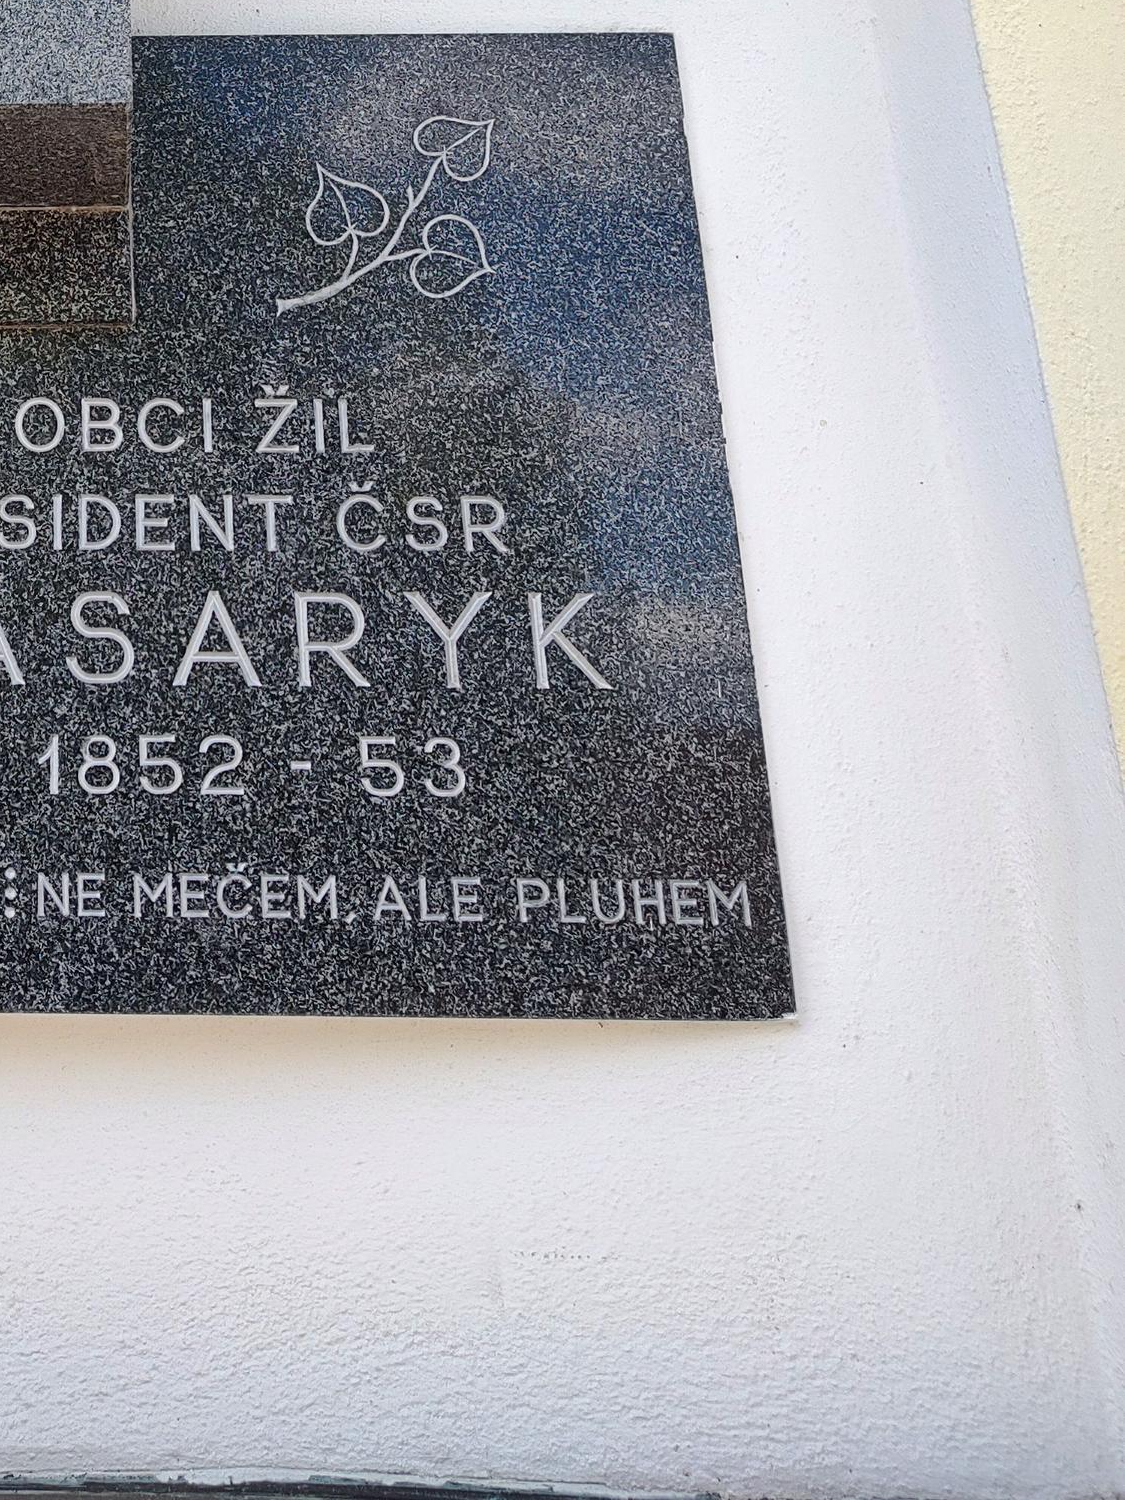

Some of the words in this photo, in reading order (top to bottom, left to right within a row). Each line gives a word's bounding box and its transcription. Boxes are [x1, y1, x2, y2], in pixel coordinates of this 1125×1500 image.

[14, 397, 215, 454] OBCI
[255, 384, 375, 454] ŽIL
[336, 481, 511, 553] ČSR
[36, 734, 246, 798] 1852
[359, 736, 466, 798] 53
[36, 872, 108, 920] NE
[133, 862, 357, 925] MEČEM,
[374, 875, 483, 923] ALE
[515, 876, 754, 928] PLUHEM
